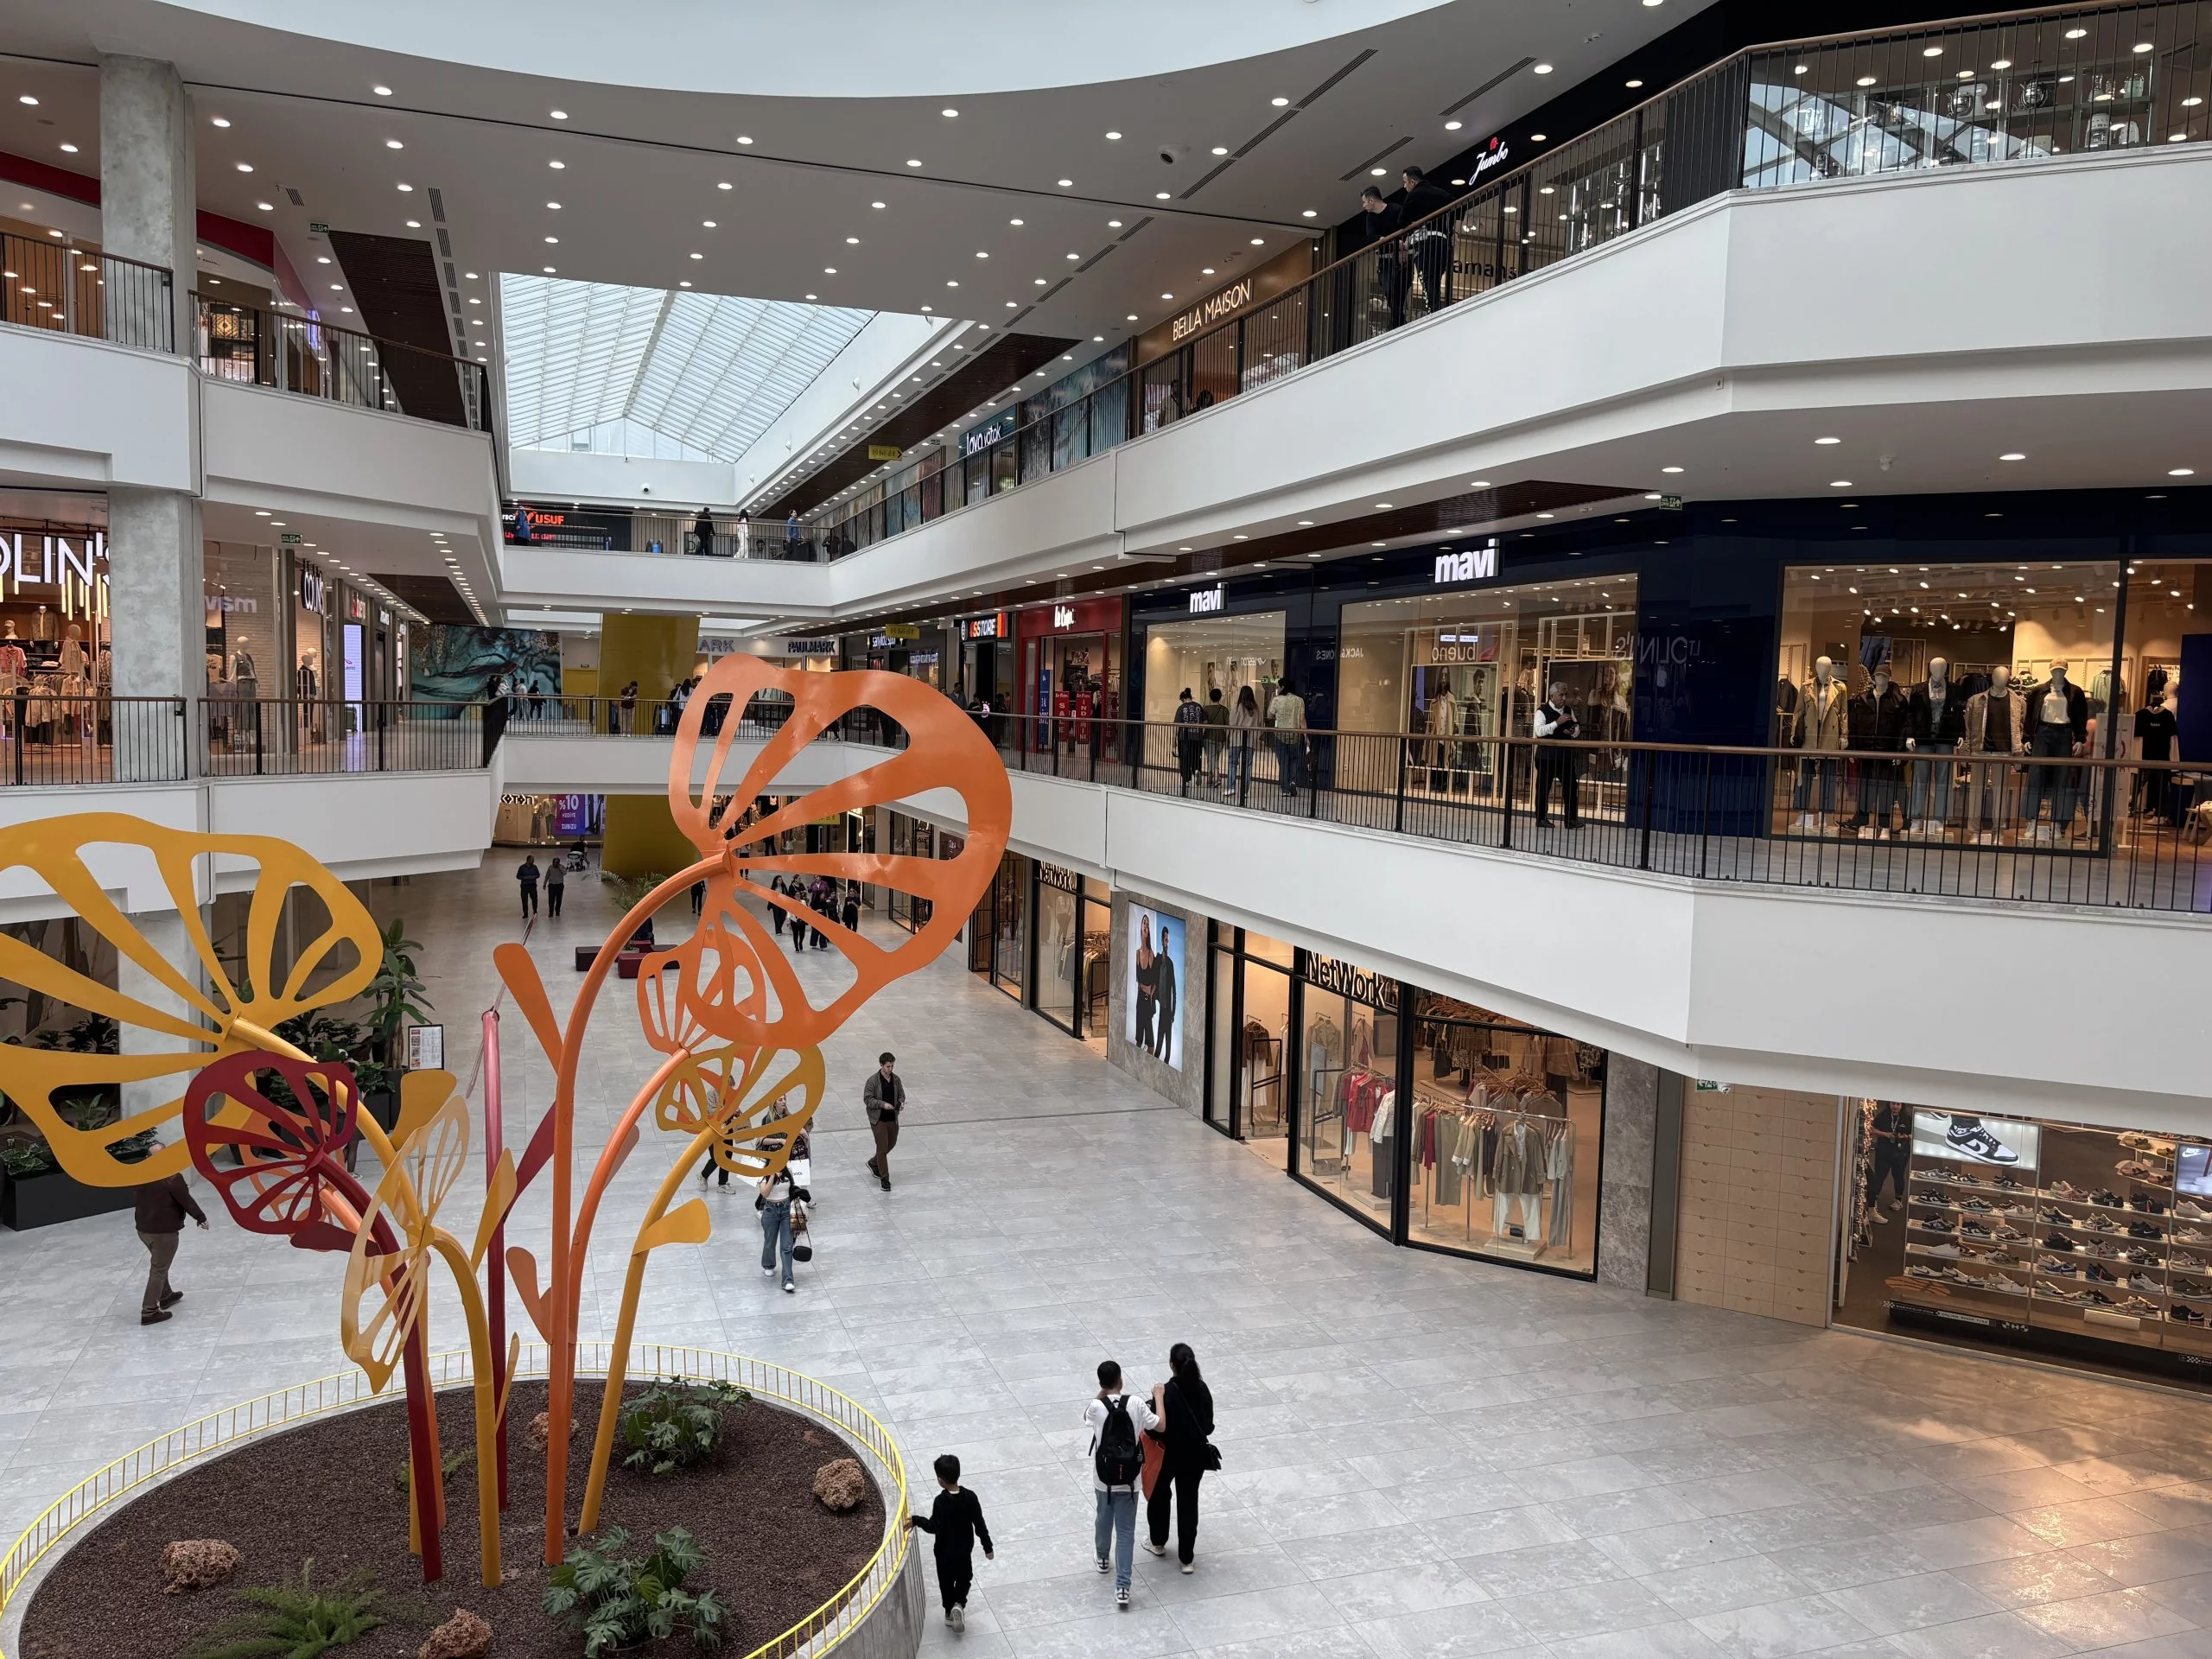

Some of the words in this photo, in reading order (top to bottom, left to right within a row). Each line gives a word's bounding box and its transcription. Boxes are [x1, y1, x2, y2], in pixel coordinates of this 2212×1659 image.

[1469, 141, 1509, 186] Jumbo
[1173, 307, 1202, 341] BELLA
[1205, 278, 1250, 324] MAISON
[0, 531, 111, 587] LIN'
[1435, 538, 1496, 583] mavi
[1189, 582, 1222, 613] mavi
[787, 640, 828, 654] PAULMARK
[558, 794, 580, 810] %10
[1306, 950, 1386, 1008] NetWork
